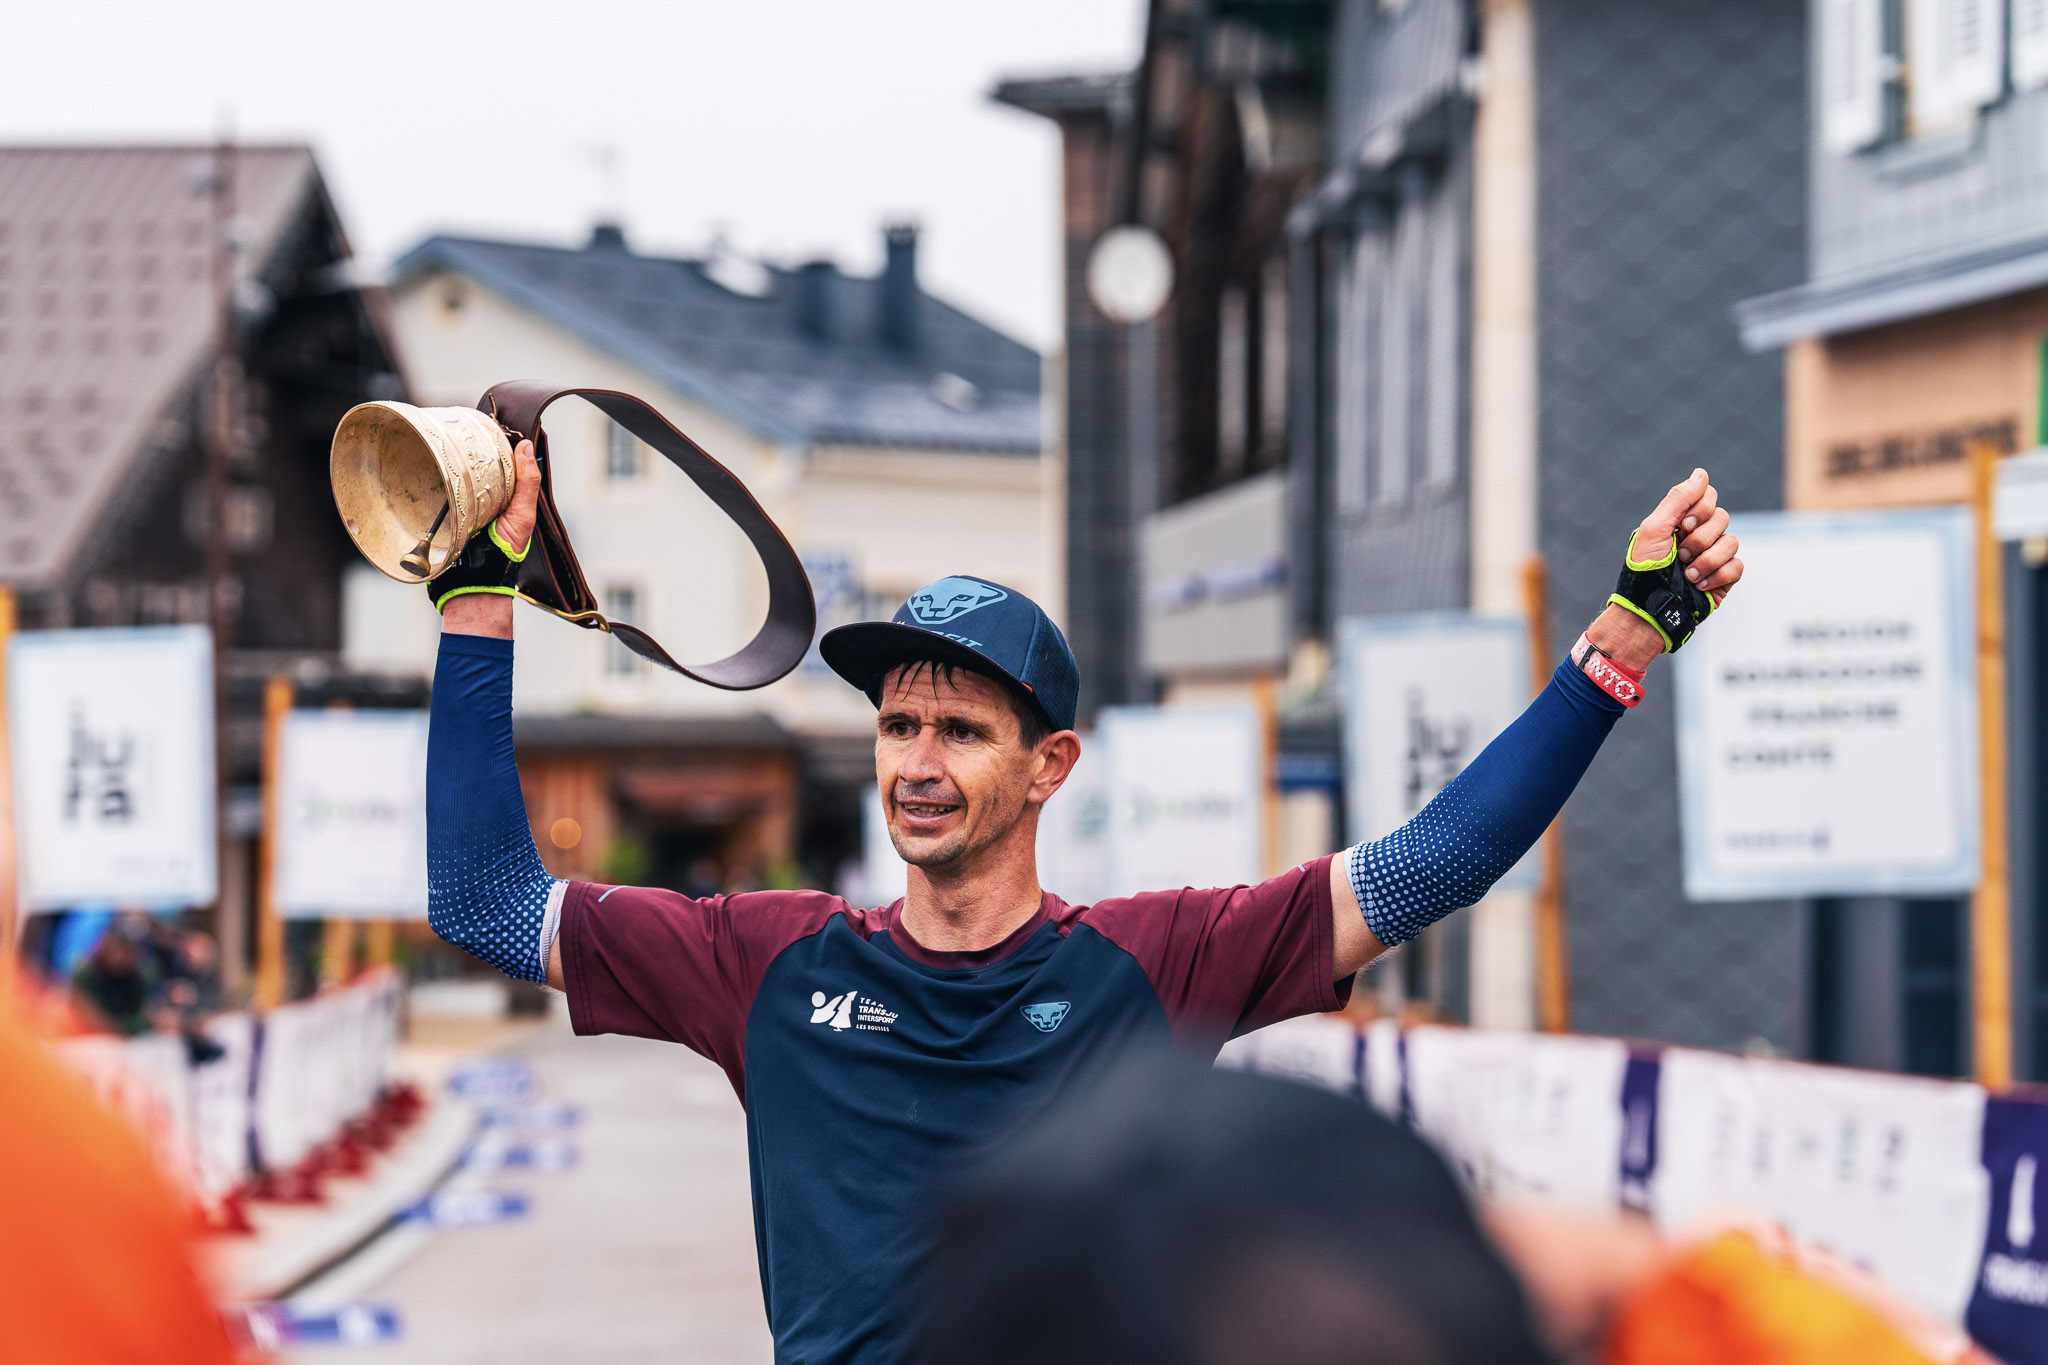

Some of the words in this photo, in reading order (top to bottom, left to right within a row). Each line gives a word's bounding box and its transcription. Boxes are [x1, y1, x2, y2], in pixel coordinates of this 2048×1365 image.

[1584, 656, 1636, 701] NTO
[860, 997, 884, 1008] TEAM
[859, 1006, 898, 1018] TRANSJU
[857, 1015, 895, 1024] INTERSPORT
